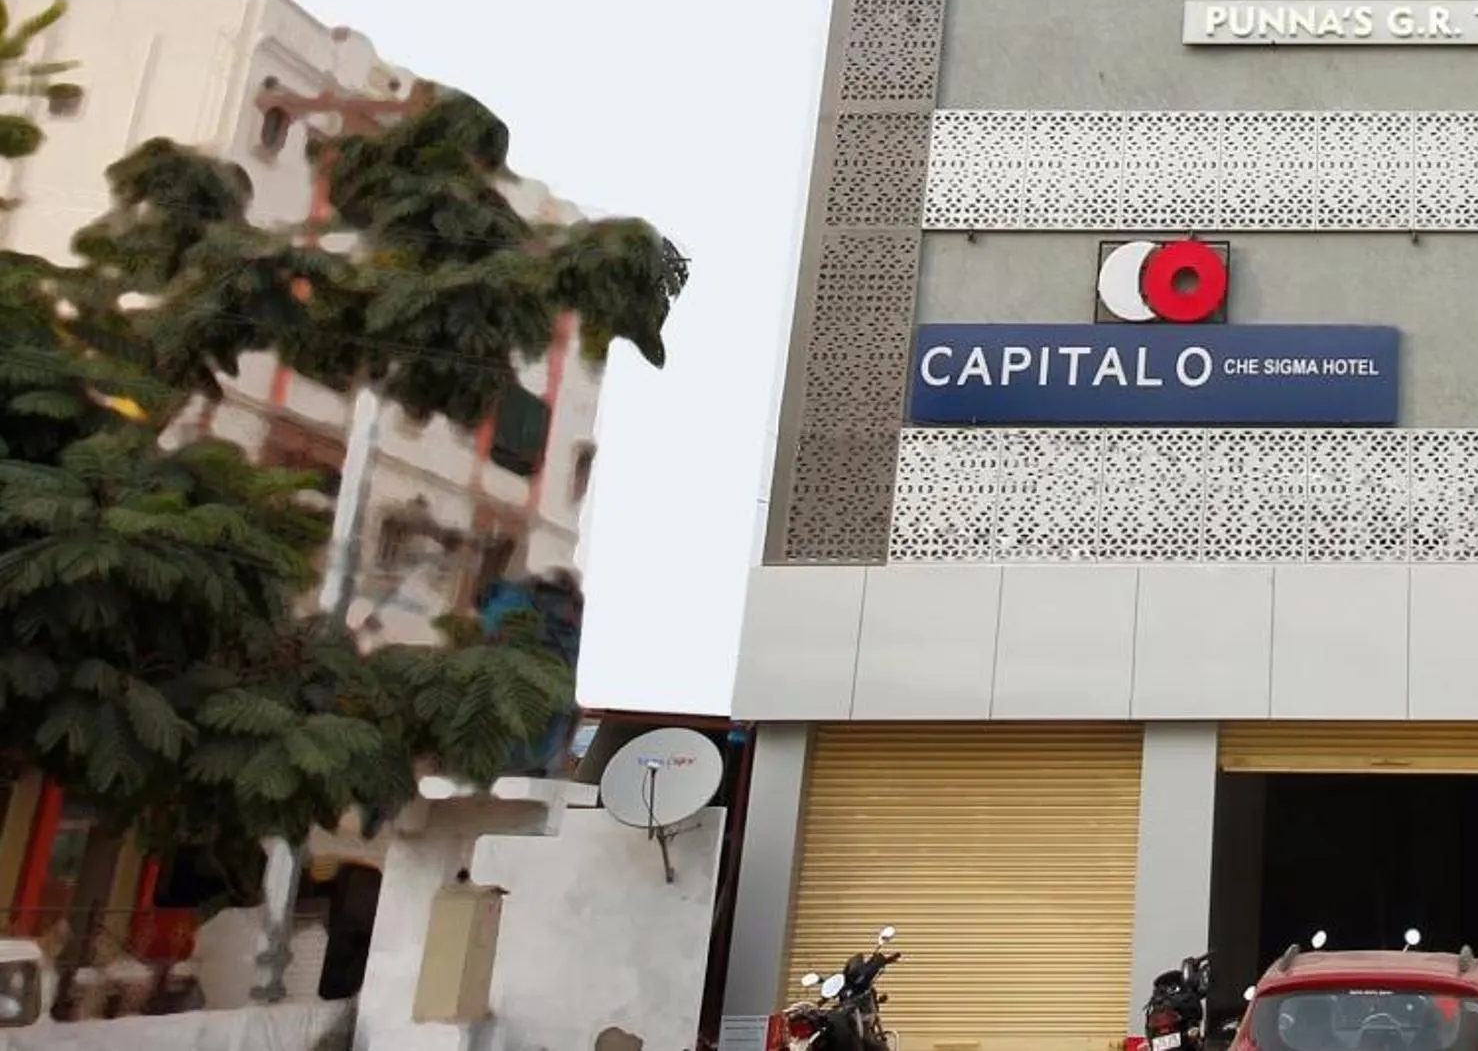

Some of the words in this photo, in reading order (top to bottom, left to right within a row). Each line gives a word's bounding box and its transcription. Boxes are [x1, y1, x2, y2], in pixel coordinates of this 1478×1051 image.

[1206, 5, 1373, 38] PUNNA'S
[1387, 6, 1465, 38] G.R.
[920, 346, 1163, 387] CAPITAL
[1176, 347, 1213, 386] O
[1223, 358, 1260, 375] CHE
[1264, 358, 1319, 376] SIGMA
[1323, 358, 1379, 376] HOTEL
